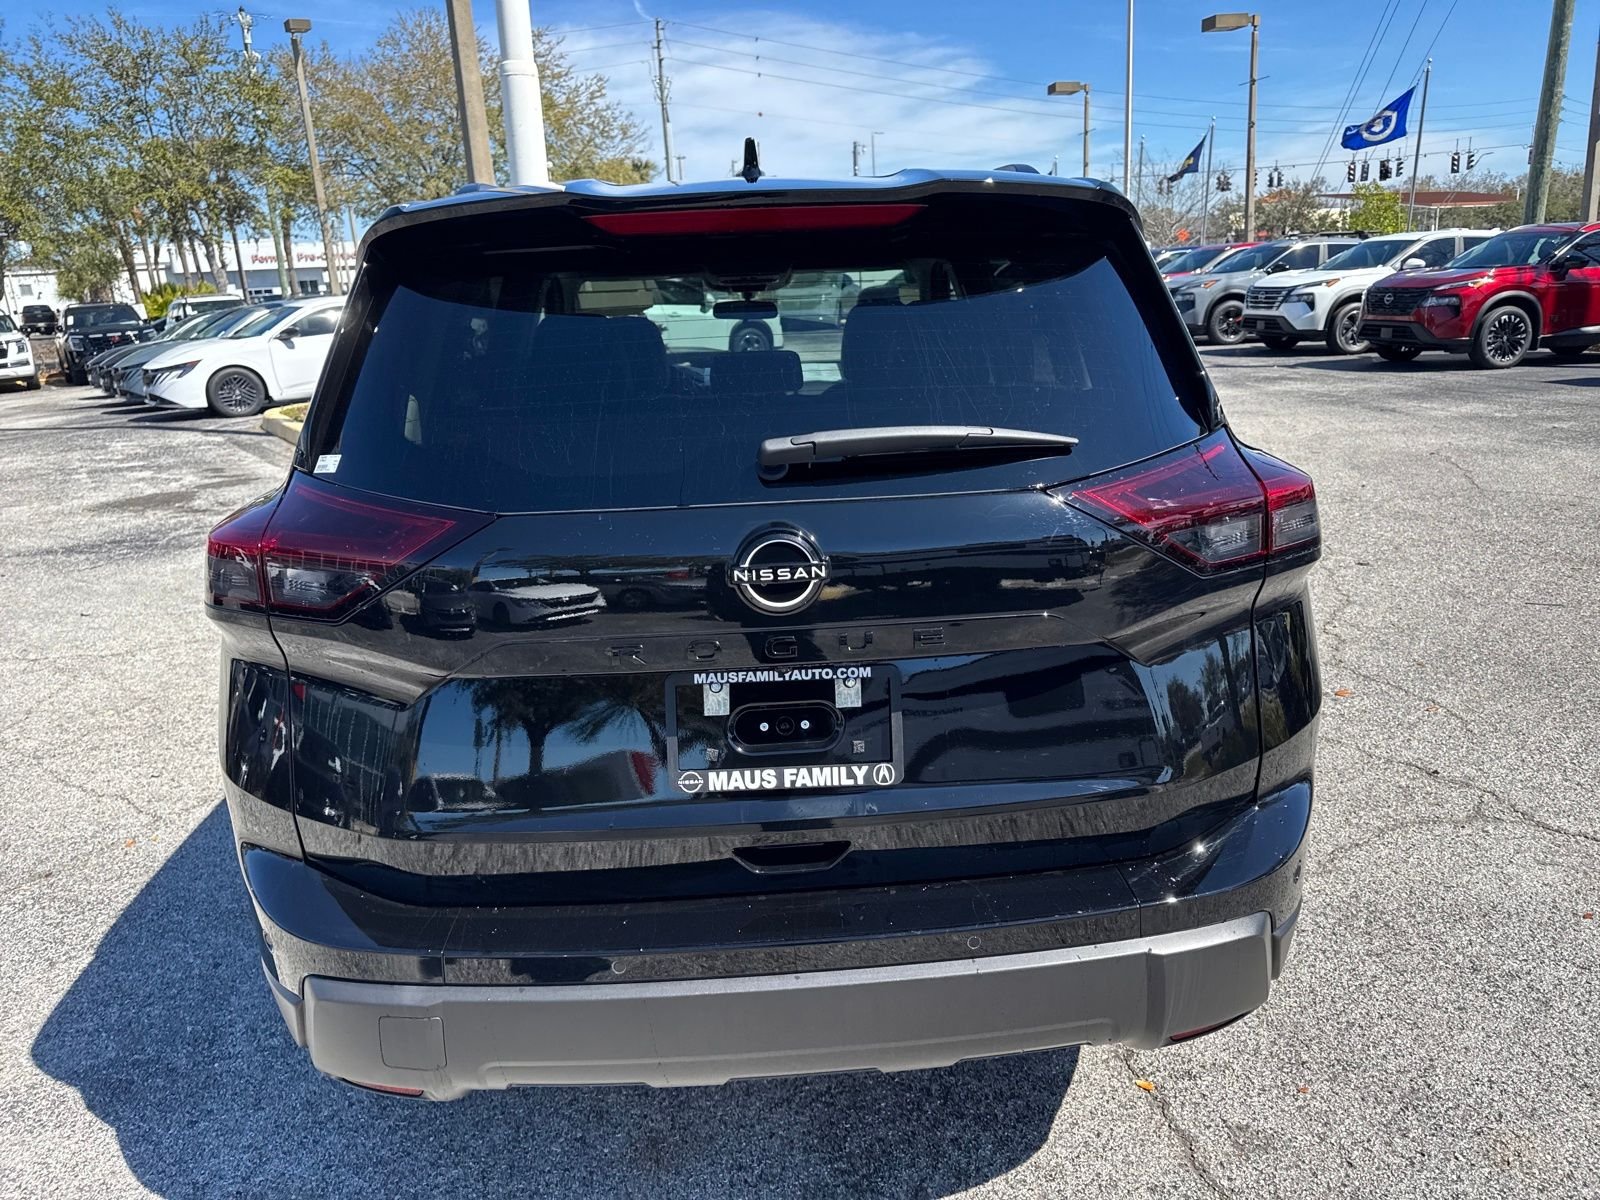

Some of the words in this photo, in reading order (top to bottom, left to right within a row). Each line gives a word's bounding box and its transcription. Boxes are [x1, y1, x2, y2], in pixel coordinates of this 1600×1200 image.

[733, 566, 826, 581] NISSAN
[608, 627, 946, 665] ROGUE
[693, 667, 872, 684] MAUSFAMILYAUTO.COM
[708, 769, 777, 791] MAUS
[783, 765, 869, 787] FAMILY
